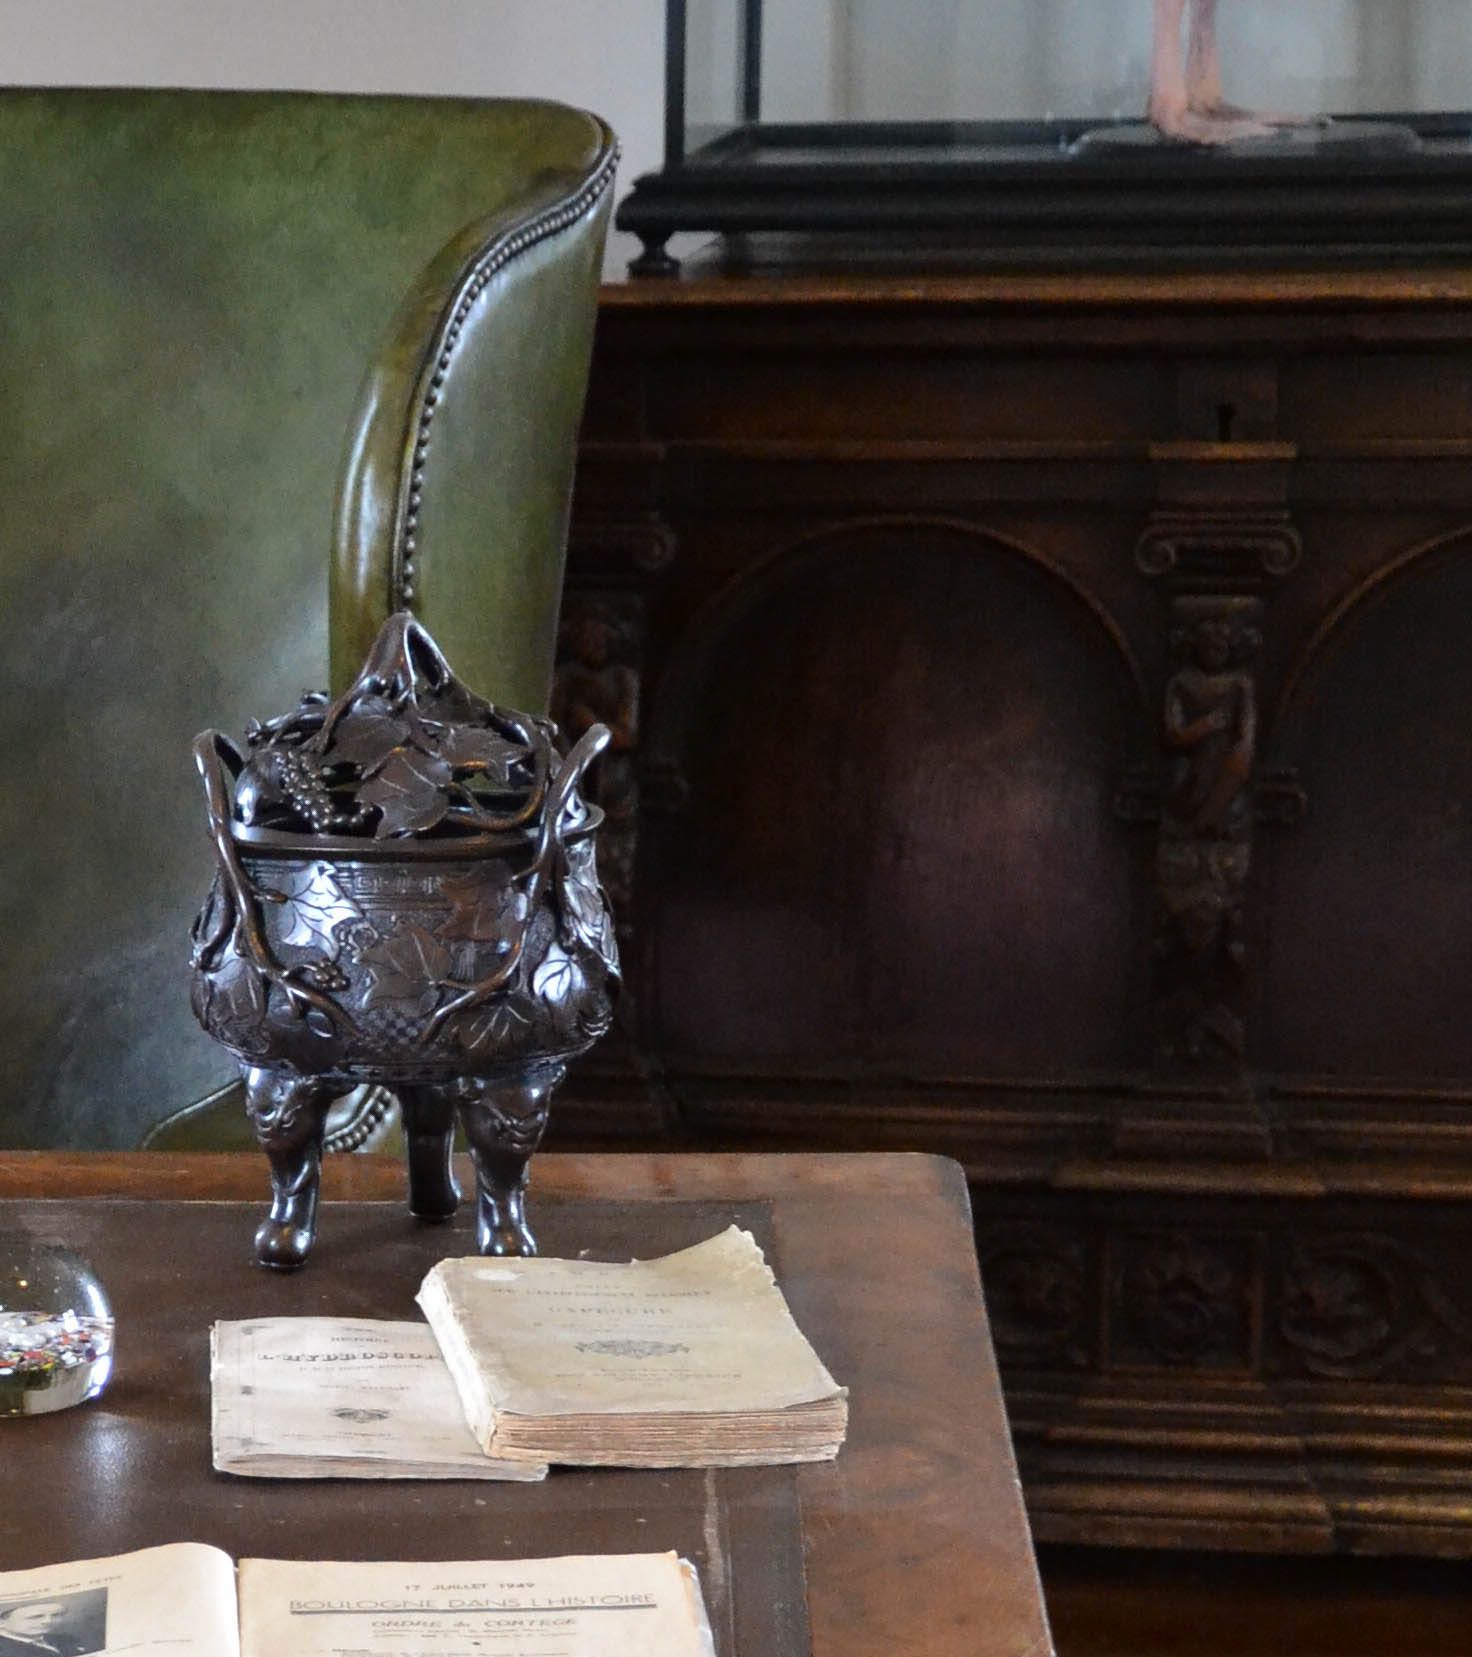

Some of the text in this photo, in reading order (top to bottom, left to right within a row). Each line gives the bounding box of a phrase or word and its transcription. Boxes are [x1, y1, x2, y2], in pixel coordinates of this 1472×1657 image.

[431, 1582, 487, 1591] JUILLET
[288, 1598, 441, 1610] BOULOGNE
[447, 1598, 520, 1609] DANS
[370, 1619, 443, 1629] ORDRE
